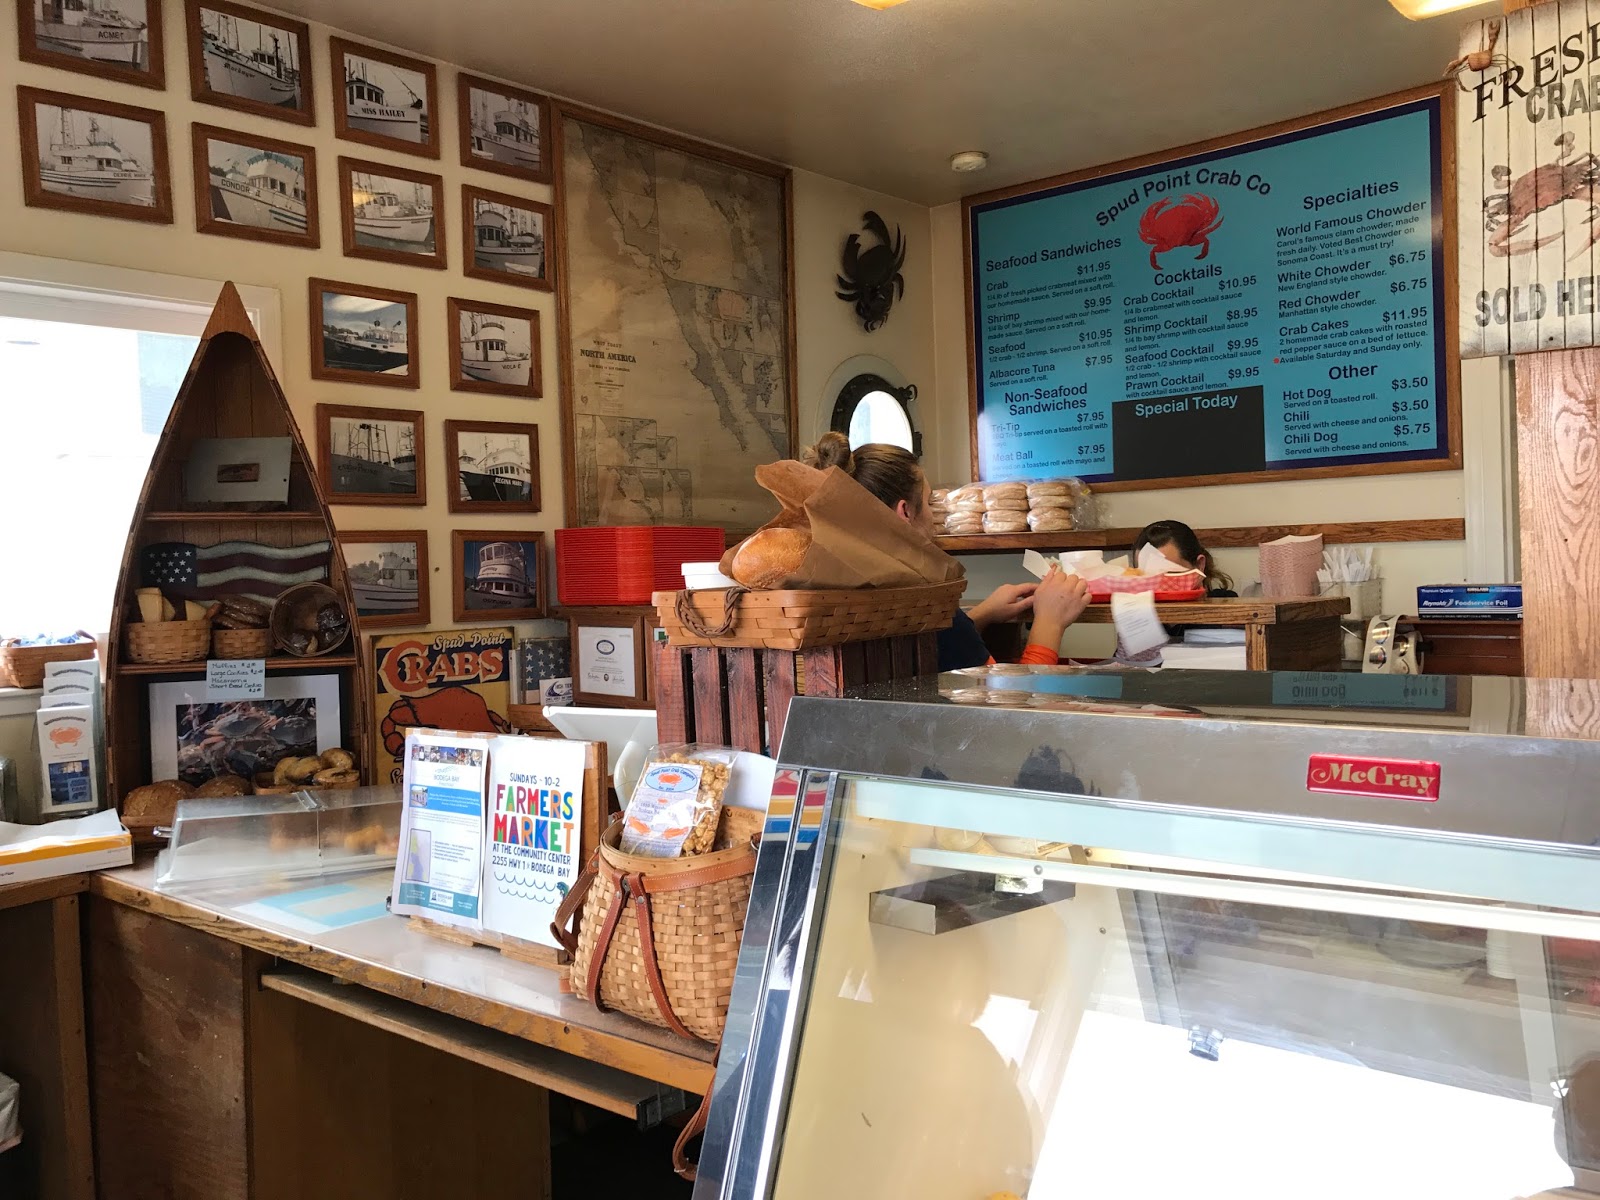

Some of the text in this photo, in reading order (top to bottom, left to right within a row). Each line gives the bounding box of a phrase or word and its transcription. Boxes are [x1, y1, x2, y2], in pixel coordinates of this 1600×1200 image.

[361, 107, 406, 118] MISS HAILEY
[1096, 168, 1271, 227] Spud Point Crab Co
[1303, 181, 1399, 211] Specialties
[1276, 200, 1427, 237] World Famous Chowder
[1305, 215, 1419, 243] famous chowder, made
[1320, 230, 1402, 249] Voted Chowder
[986, 238, 1122, 272] Seafood Sandwiches
[1277, 256, 1308, 266] Sonoma
[1077, 261, 1110, 275] $11.95
[1154, 264, 1222, 286] Cocktails
[1277, 250, 1426, 283] White Chowder $6.75
[986, 281, 1008, 292] Crab
[1123, 275, 1256, 306] Crab Cocktail $10.95
[1278, 274, 1348, 292] New England style
[1084, 296, 1111, 309] $9.95
[1278, 278, 1427, 310] Red Chowder $6.75
[1557, 274, 1600, 318] HE
[1143, 302, 1174, 313] crabmeat
[1192, 295, 1219, 305] cocktail
[1279, 304, 1339, 318] Manhattan style
[1475, 282, 1548, 328] SOLD
[987, 312, 1020, 324] Shrimp
[1124, 307, 1258, 336] Shrimp Cocktail $8.95
[1198, 321, 1248, 333] cocktail sauce
[1279, 307, 1427, 337] Crab Cakes $11.95
[1079, 329, 1112, 342] $10.95
[1286, 334, 1328, 345] homemade
[1330, 331, 1348, 339] crab
[1350, 327, 1373, 336] cakes
[1395, 320, 1427, 330] roasted
[580, 349, 636, 363] NORTH AMERICA
[988, 341, 1026, 354] Seafood
[1125, 338, 1258, 364] Seafood Cocktail $9.95
[1280, 343, 1401, 364] Available Saturday Sunday
[1294, 340, 1347, 355] pepper sauce
[1086, 355, 1112, 367] $7.95
[1169, 358, 1192, 367] shrimp
[1210, 352, 1238, 361] cocktail
[989, 364, 1055, 380] Albacore Tuna
[1126, 367, 1259, 391] Prawn Cocktail $9.95
[1328, 365, 1378, 380] Other
[1005, 383, 1088, 404] Non-Seafood
[1141, 387, 1167, 397] cocktail
[1283, 376, 1428, 401] Hot Dog $3.50
[1009, 398, 1086, 416] Sandwiches
[1135, 394, 1238, 418] Special Today
[1284, 400, 1310, 409] Served
[1284, 400, 1429, 423] Chili $3.50
[1077, 412, 1104, 423] $7.95
[1284, 423, 1311, 432] Served
[1331, 418, 1359, 427] cheese
[1024, 428, 1044, 436] served
[1284, 423, 1430, 444] Chili Dog $5.75
[1016, 451, 1032, 460] Ball
[1078, 444, 1105, 455] $7.95
[1285, 447, 1312, 456] Served
[433, 632, 506, 652] Spud Point
[378, 640, 503, 699] CRABS
[510, 772, 560, 787] SUNDAYS 10-2
[1310, 762, 1436, 794] McCray
[496, 784, 574, 820] FARMERS
[493, 812, 574, 854] MARKET
[492, 843, 571, 865] AT THE COMMUNITY CENTER
[492, 855, 570, 878] 2255 HWY 1 BODEGA BAY
